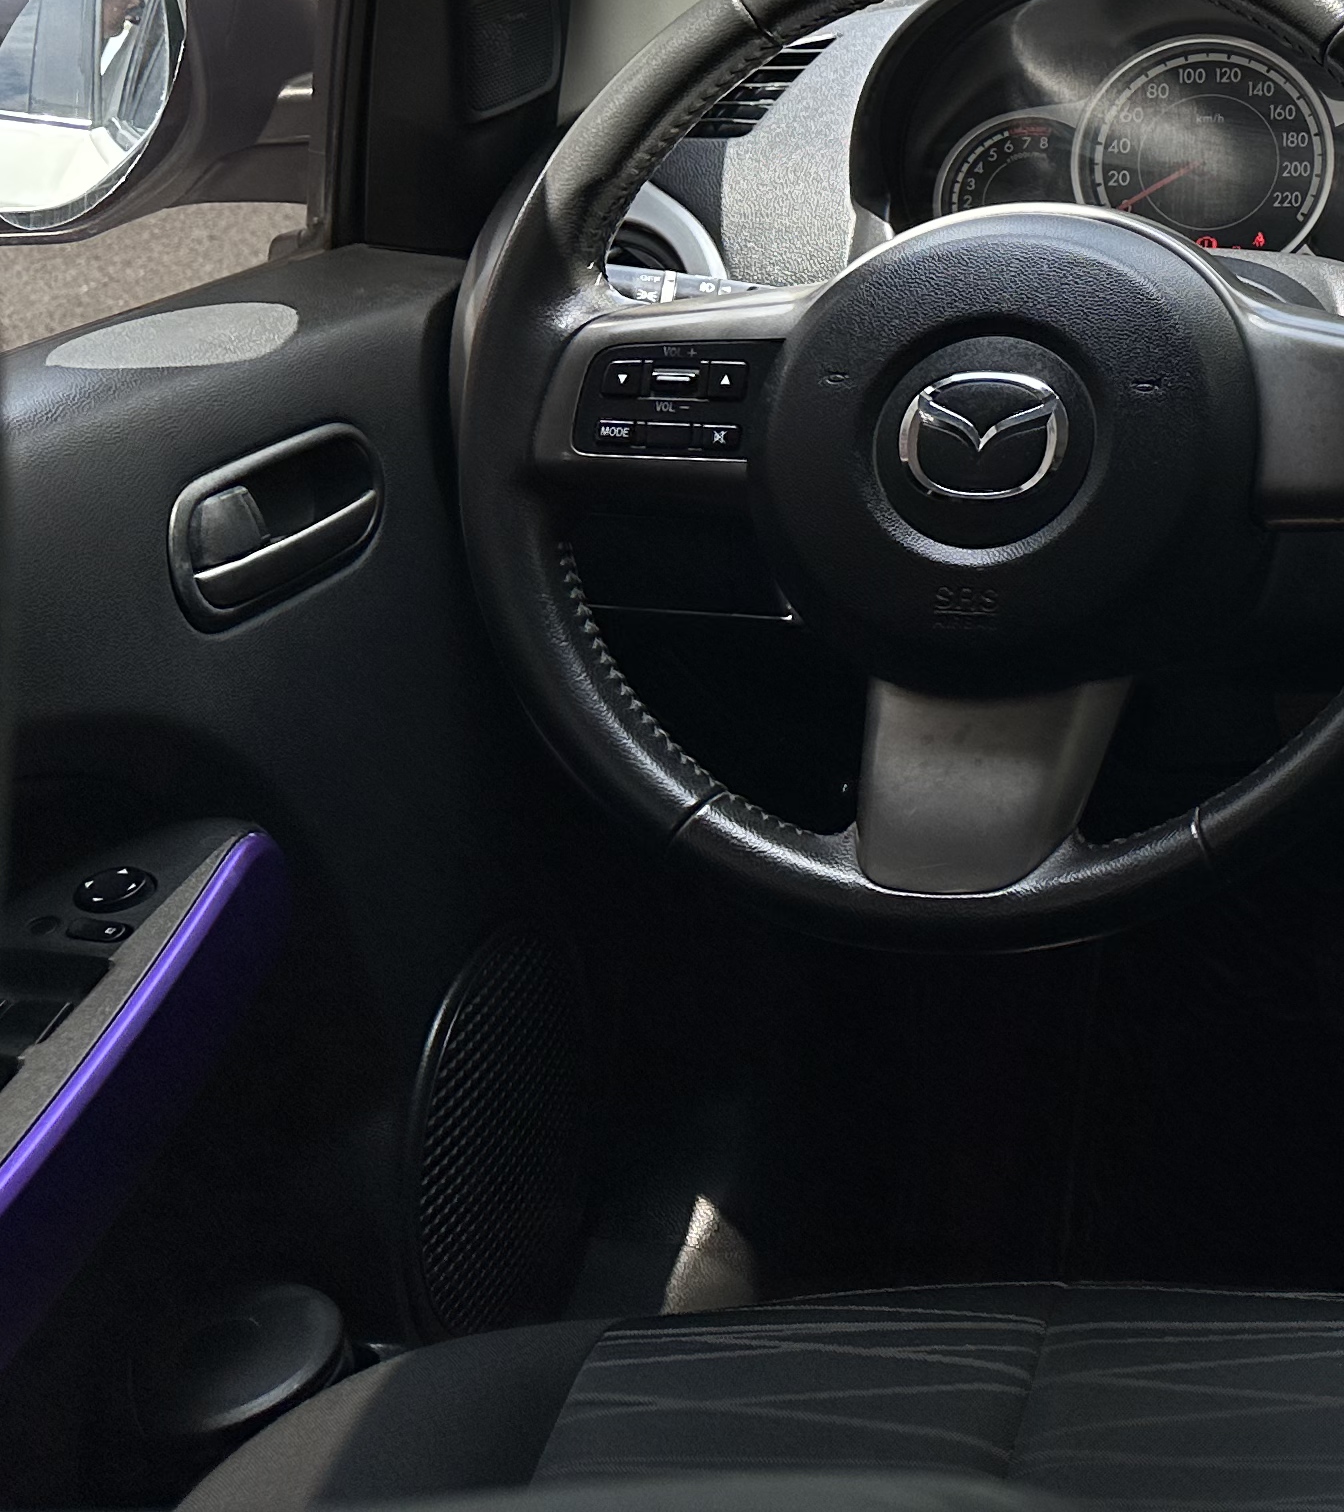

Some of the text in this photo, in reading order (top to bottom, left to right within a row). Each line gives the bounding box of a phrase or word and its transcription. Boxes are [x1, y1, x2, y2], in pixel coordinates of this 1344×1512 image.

[1178, 68, 1206, 84] 100
[1215, 67, 1242, 83] 120
[1146, 83, 1170, 99] 80
[1248, 81, 1275, 97] 140
[1119, 107, 1144, 123] 60
[1269, 104, 1296, 120] 160
[1003, 140, 1014, 153] 6
[1021, 136, 1032, 150] 7
[1039, 136, 1049, 150] 8
[1107, 138, 1131, 154] 40
[1282, 132, 1309, 148] 180
[987, 148, 998, 162] 5
[973, 161, 984, 174] 4
[1282, 161, 1311, 178] 200
[966, 177, 976, 191] 3
[1107, 170, 1131, 187] 20
[963, 195, 973, 208] 2
[1273, 192, 1302, 208] 220
[662, 345, 683, 358] VOL
[655, 401, 676, 414] VOL
[600, 426, 630, 439] MODE
[935, 585, 1000, 613] SRS
